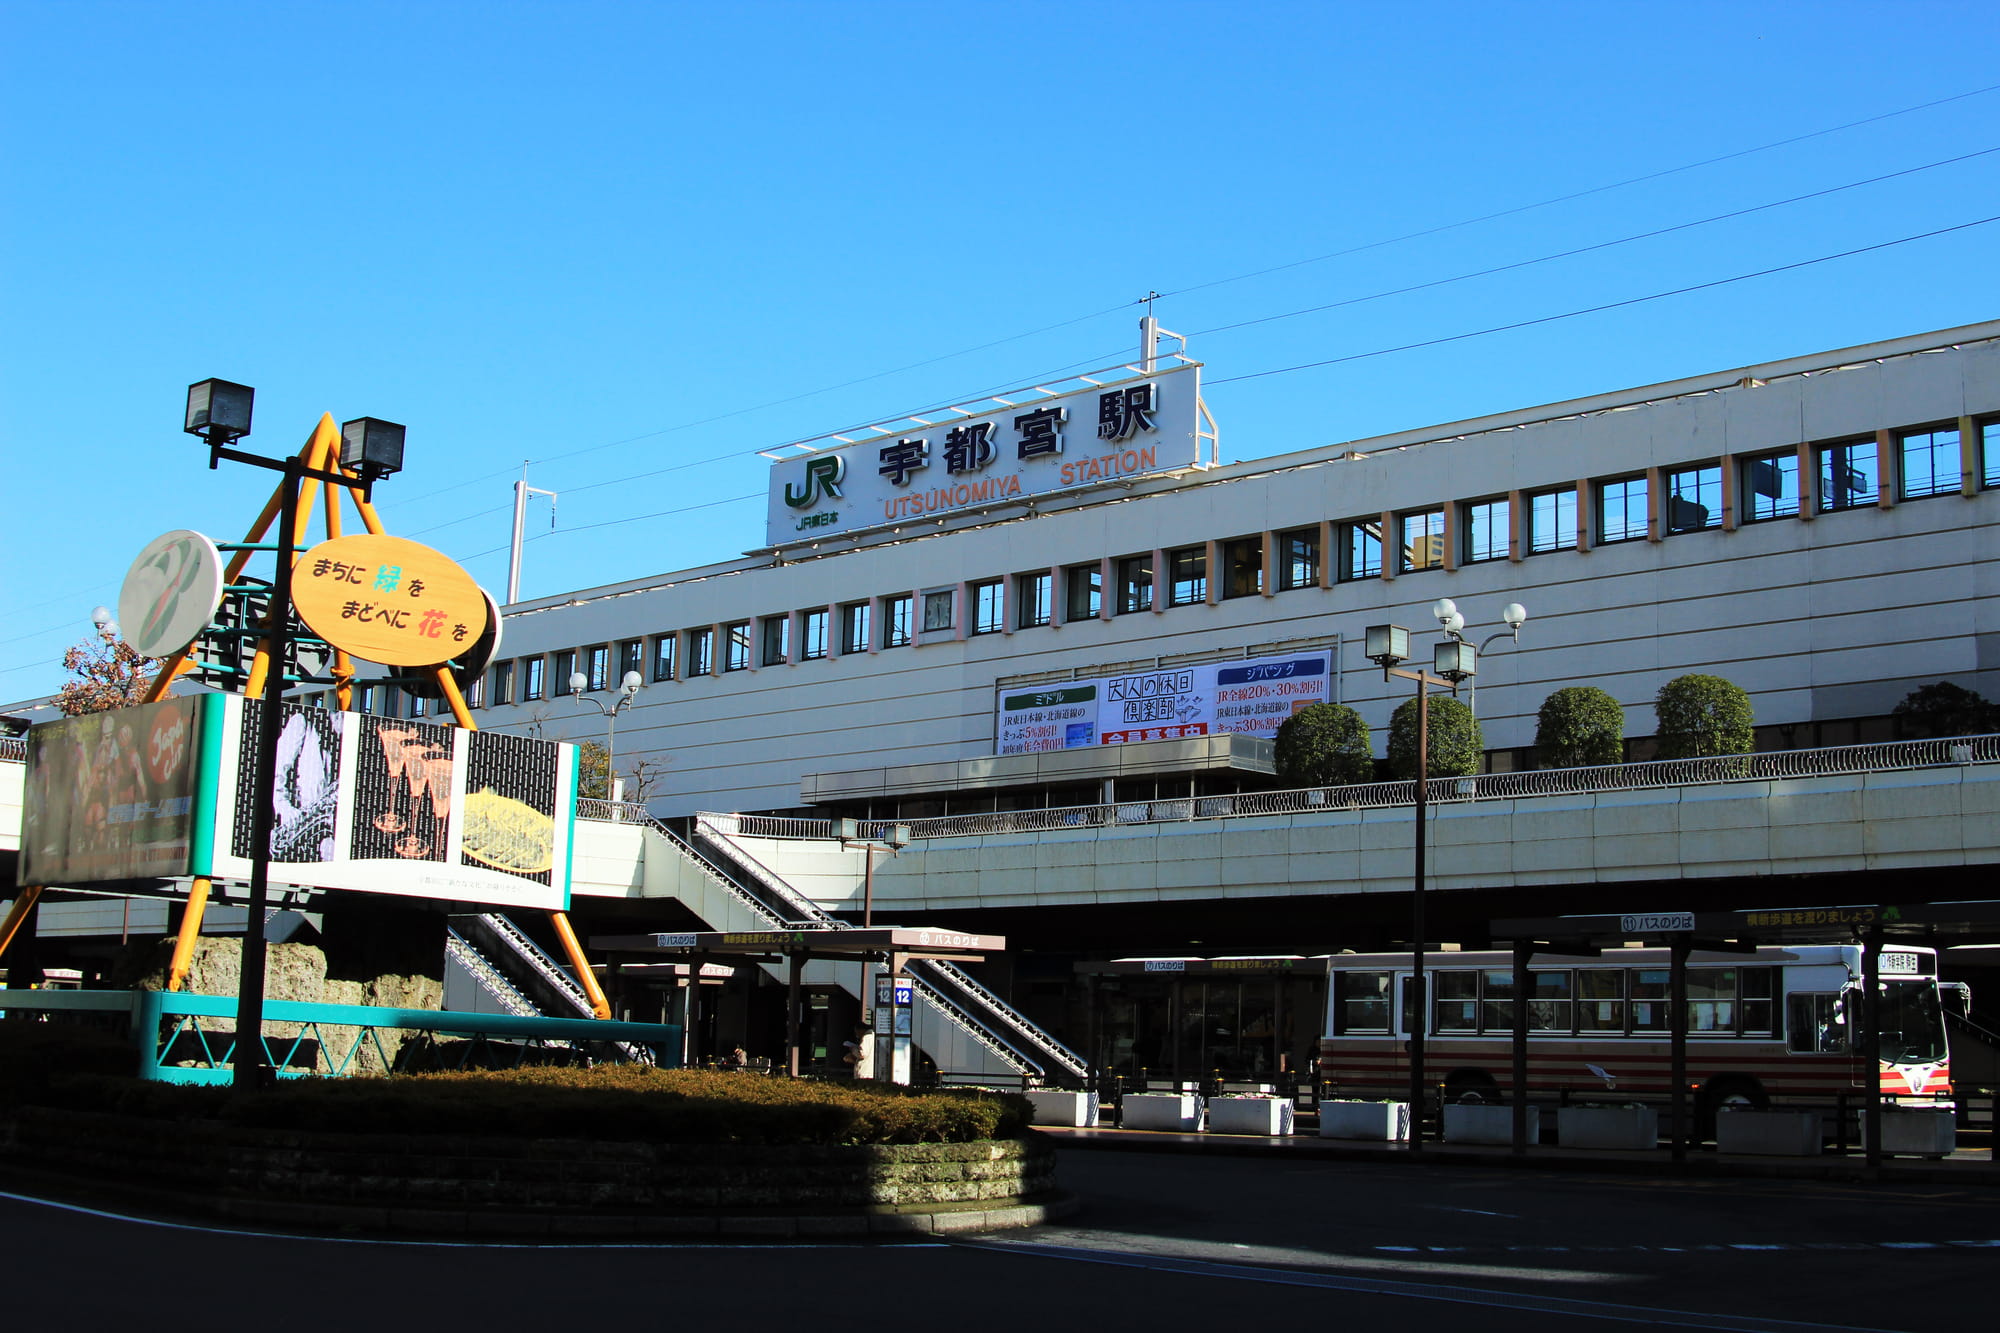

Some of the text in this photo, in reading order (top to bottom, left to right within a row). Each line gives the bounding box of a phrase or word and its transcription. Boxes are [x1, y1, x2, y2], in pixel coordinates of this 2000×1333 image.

[878, 382, 1158, 485] 宇都宮駅
[785, 455, 844, 508] JR
[884, 446, 1156, 519] UTSUNOMIYA STATION
[796, 510, 839, 531] JR東日本
[1035, 691, 1064, 705] ミドル
[1109, 671, 1191, 701] 大人の休日
[1125, 697, 1175, 722] 倶楽部
[1217, 716, 1287, 732] きっぷ30%割引
[896, 990, 910, 1003] 12
